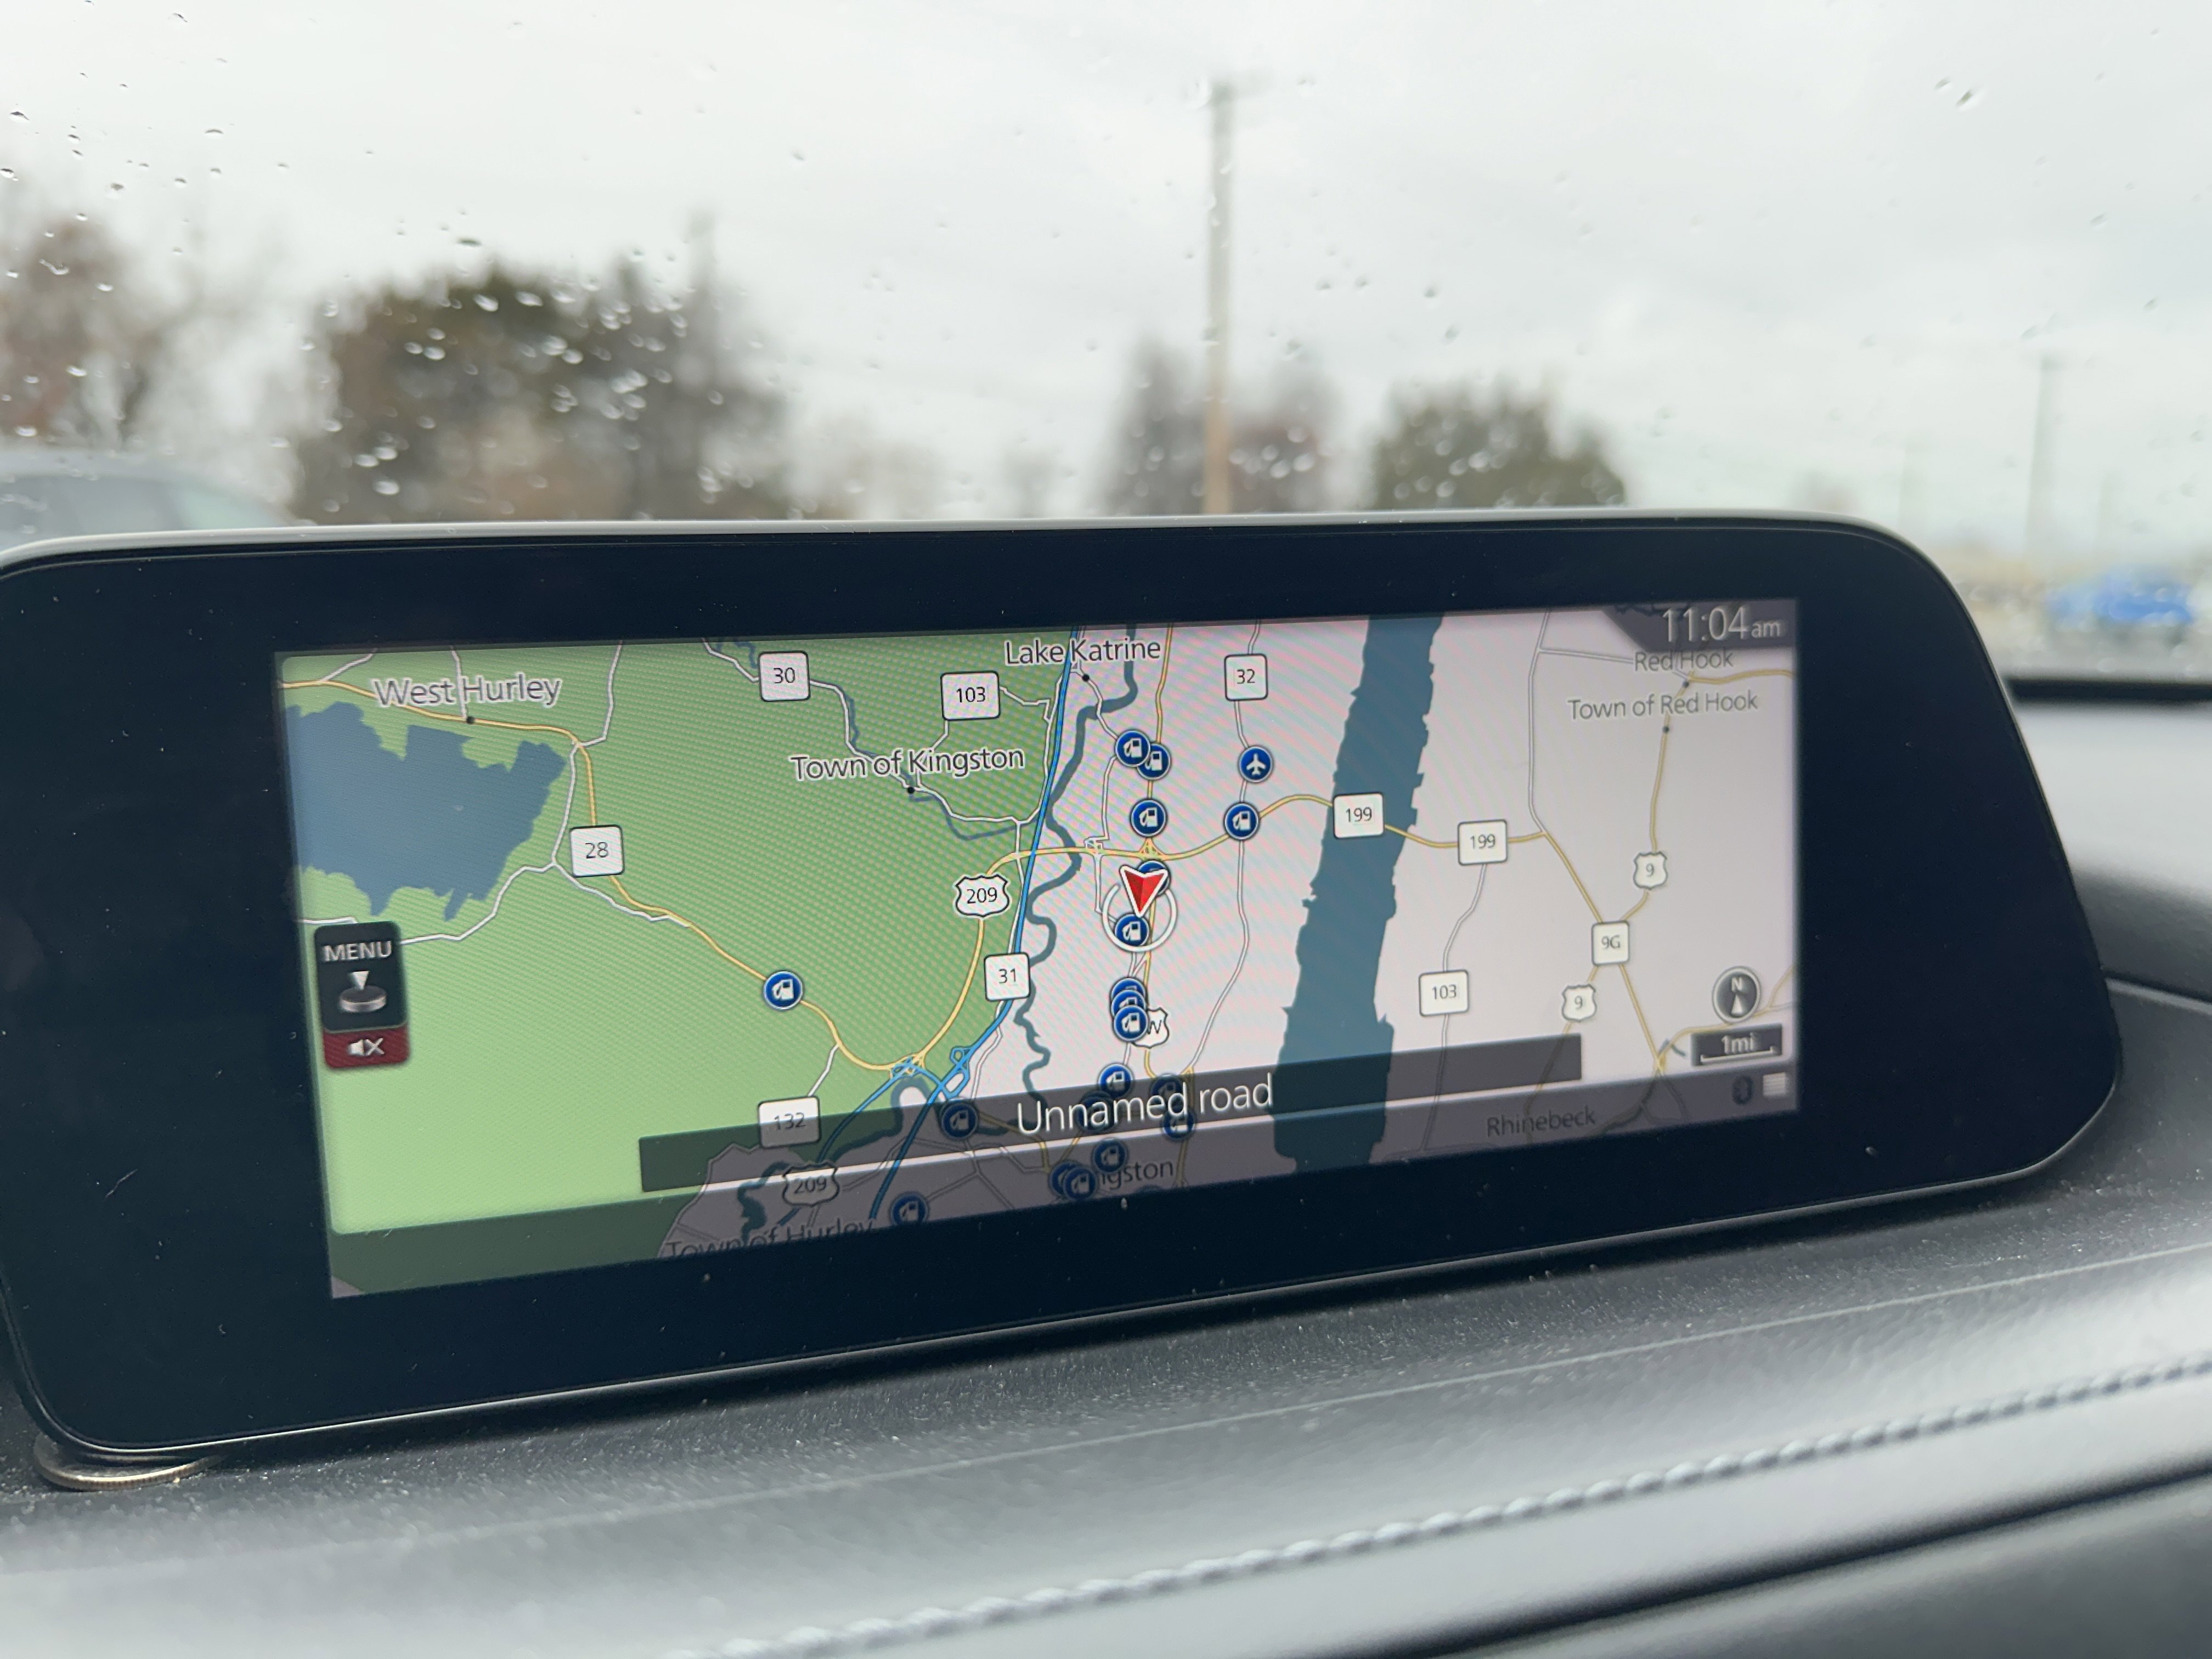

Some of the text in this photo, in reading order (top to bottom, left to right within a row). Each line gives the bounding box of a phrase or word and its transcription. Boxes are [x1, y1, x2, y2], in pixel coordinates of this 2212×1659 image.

[1005, 637, 1161, 665] Lake Katrine
[1634, 647, 1734, 672] Red Hook
[774, 668, 796, 684] 30
[1236, 669, 1255, 684] 32
[375, 674, 561, 706] West Hurley
[955, 686, 986, 703] 103
[1568, 690, 1758, 720] Town of Red Hook
[790, 748, 1025, 780] Town of Kingston
[1345, 807, 1373, 822] 199
[1469, 834, 1496, 849] 199
[585, 842, 608, 859] 28
[1646, 863, 1654, 878] 9
[966, 888, 998, 904] 209
[1601, 935, 1621, 950] 9G
[323, 941, 393, 962] MENU
[998, 968, 1018, 985] 31
[1731, 977, 1743, 991] N
[1431, 985, 1457, 1000] 103
[1574, 996, 1583, 1010] 9
[1722, 1032, 1756, 1054] 1mi
[1017, 1072, 1273, 1135] Unnamed road
[774, 1111, 807, 1130] 132
[1487, 1105, 1596, 1138] Rhinebeck
[793, 1175, 827, 1194] 209
